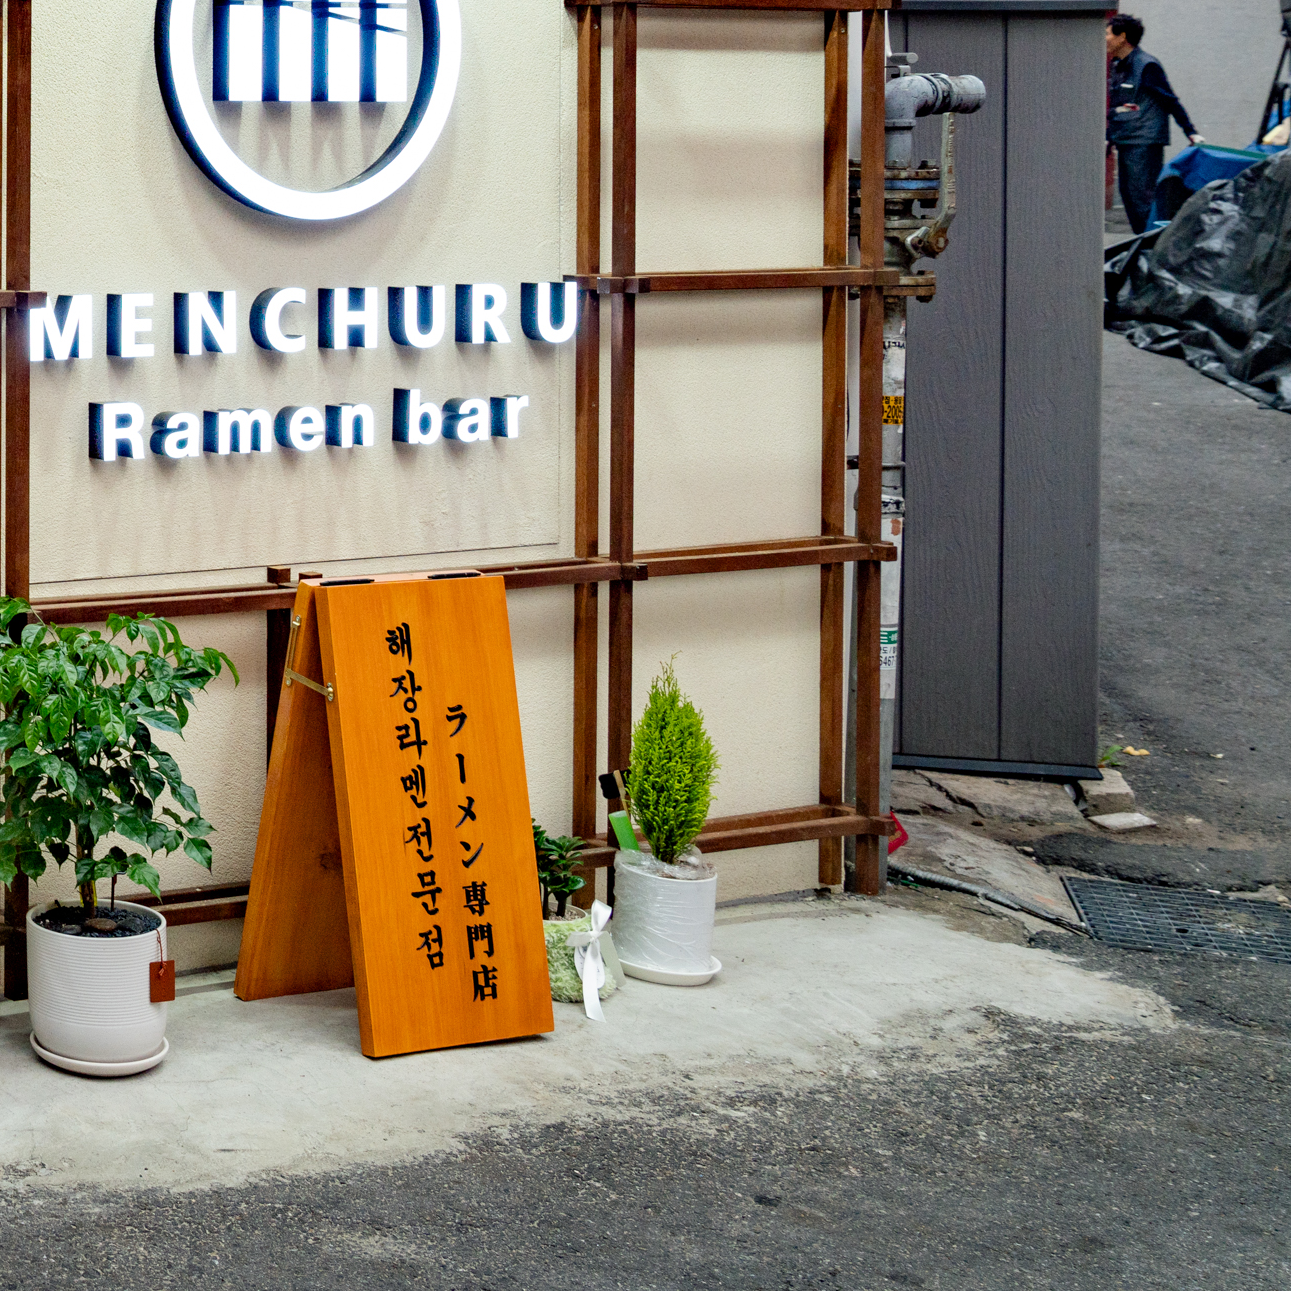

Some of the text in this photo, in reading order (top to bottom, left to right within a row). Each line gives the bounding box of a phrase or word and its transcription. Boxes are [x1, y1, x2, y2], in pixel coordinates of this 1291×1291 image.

[28, 281, 579, 361] MENCHURU
[89, 387, 529, 461] Ramen bar
[446, 705, 499, 1003] ラーメン専門店
